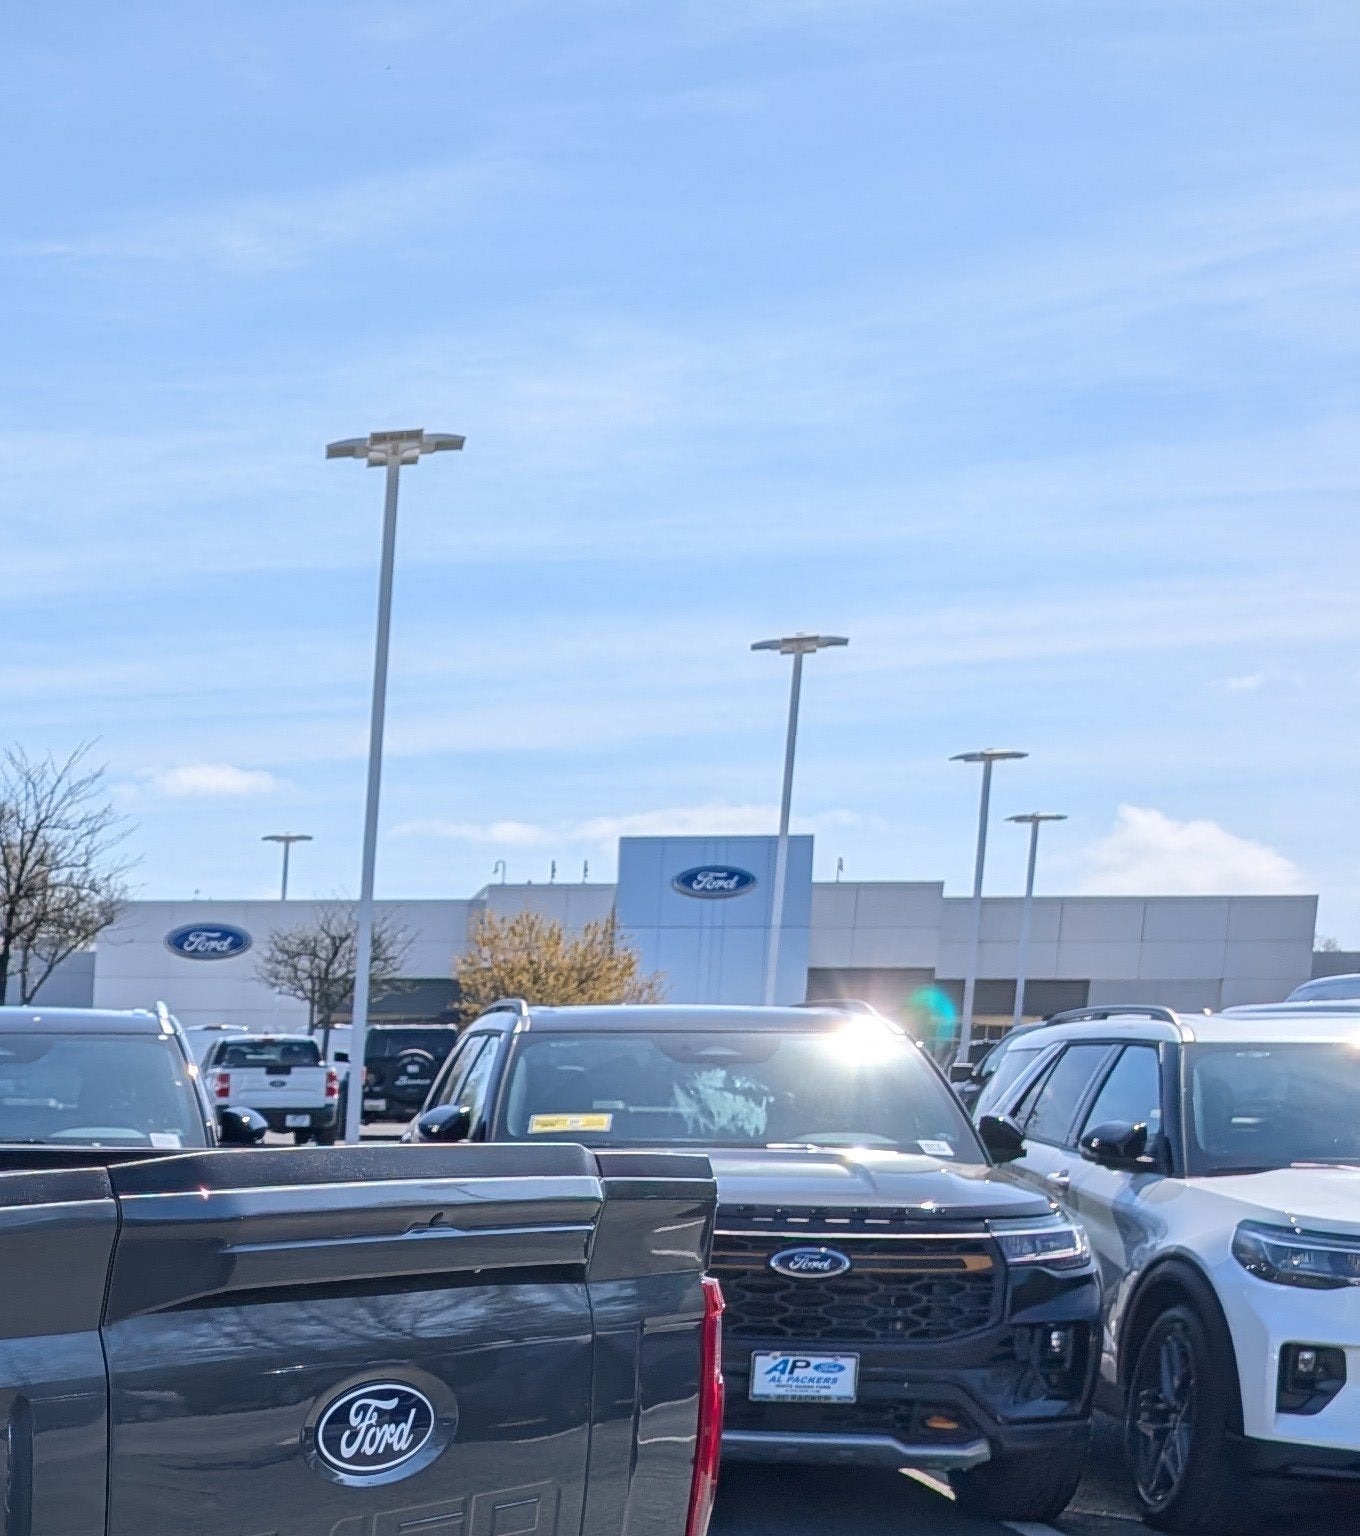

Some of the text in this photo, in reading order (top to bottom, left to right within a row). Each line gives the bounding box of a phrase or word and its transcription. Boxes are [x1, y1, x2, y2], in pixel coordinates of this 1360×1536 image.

[692, 871, 739, 890] Ford
[183, 931, 234, 952] Ford
[789, 1254, 831, 1270] Ford
[763, 1358, 811, 1375] AP
[786, 1375, 840, 1385] PACKERS
[341, 1397, 416, 1458] Ford
